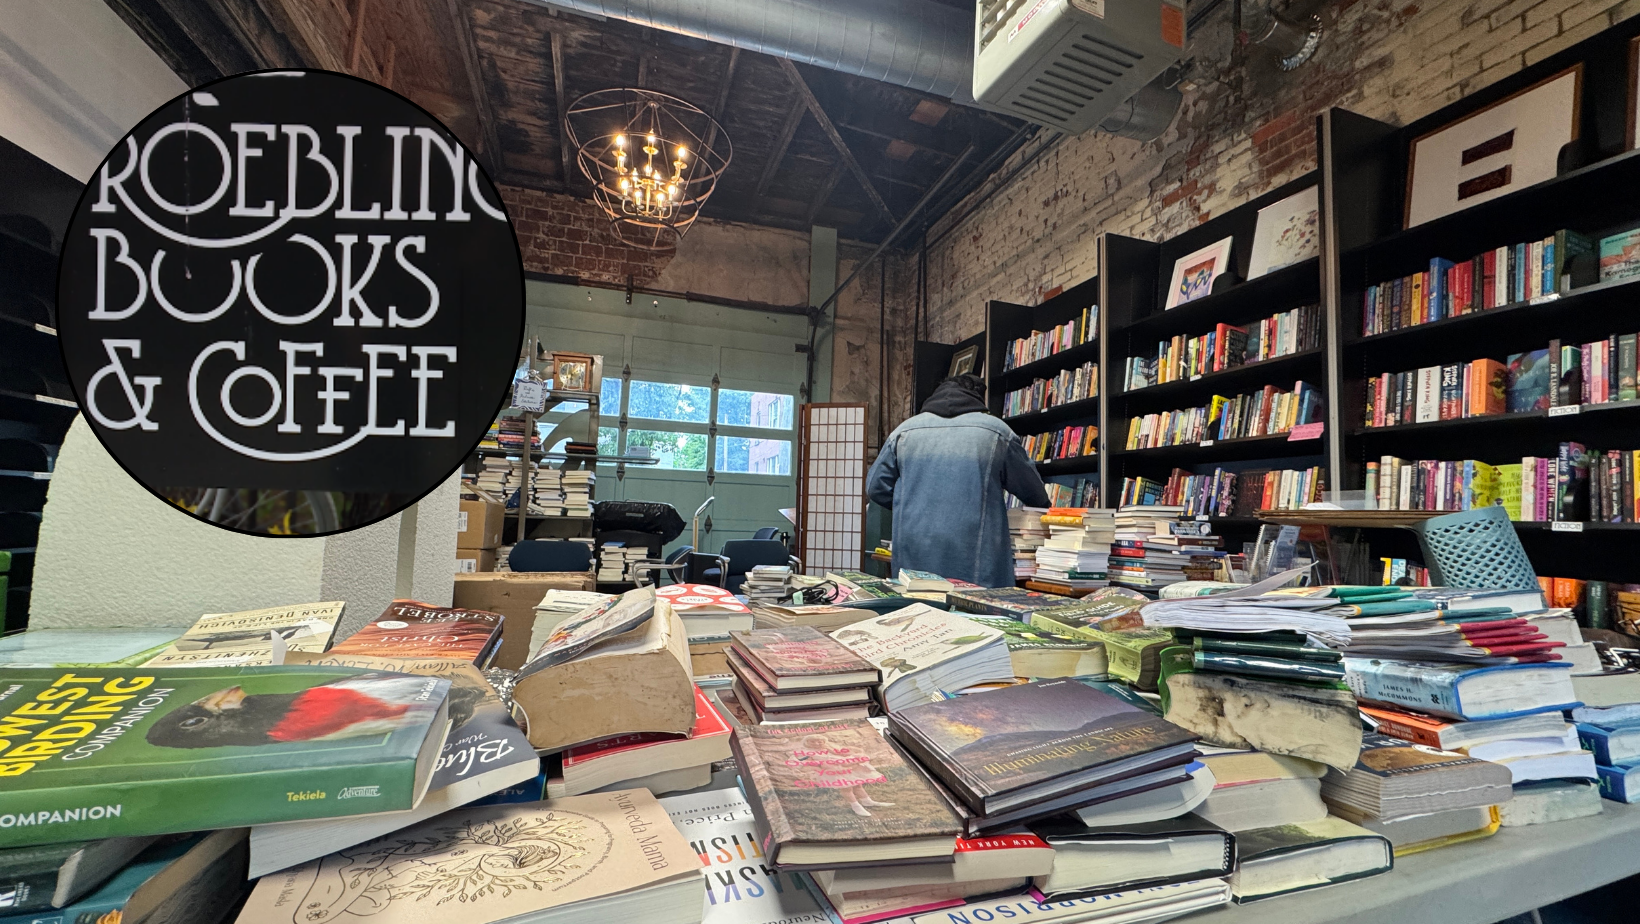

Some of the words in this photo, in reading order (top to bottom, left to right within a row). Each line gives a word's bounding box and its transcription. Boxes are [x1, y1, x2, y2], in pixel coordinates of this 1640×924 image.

[1442, 367, 1450, 386] KING
[1550, 405, 1577, 416] FICTION
[1547, 478, 1555, 501] WOMEN
[200, 611, 295, 629] DENISOVICH
[302, 608, 334, 616] IVAN
[394, 606, 496, 621] STROBEL
[420, 616, 460, 624] LEE
[381, 635, 459, 643] Christ
[876, 624, 929, 647] Backyard
[884, 622, 947, 651] Chronicles
[903, 639, 929, 652] Amy
[931, 628, 953, 639] Tan
[162, 643, 306, 662] SOZHENITSYN
[415, 660, 467, 673] Allan
[1383, 684, 1404, 692] JAMES
[1378, 691, 1422, 702] McCOMMONS
[0, 674, 104, 750] WEST
[62, 688, 175, 761] COMPANION
[786, 726, 815, 734] SCHOOL
[455, 733, 488, 746] War
[597, 733, 652, 749] RTS
[435, 739, 515, 776] Blue
[982, 741, 1097, 776] Illuminating
[1093, 726, 1156, 745] Nature
[784, 756, 870, 767] Overcome
[815, 768, 853, 777] Your
[794, 775, 888, 788] Childhood
[287, 789, 326, 802] Tekiela
[0, 804, 122, 828] OMPANION
[680, 810, 736, 826] Price,
[608, 792, 653, 834] Ayurveda
[637, 834, 669, 871] Mama
[690, 832, 763, 866] TISM
[978, 840, 1007, 848] YORK
